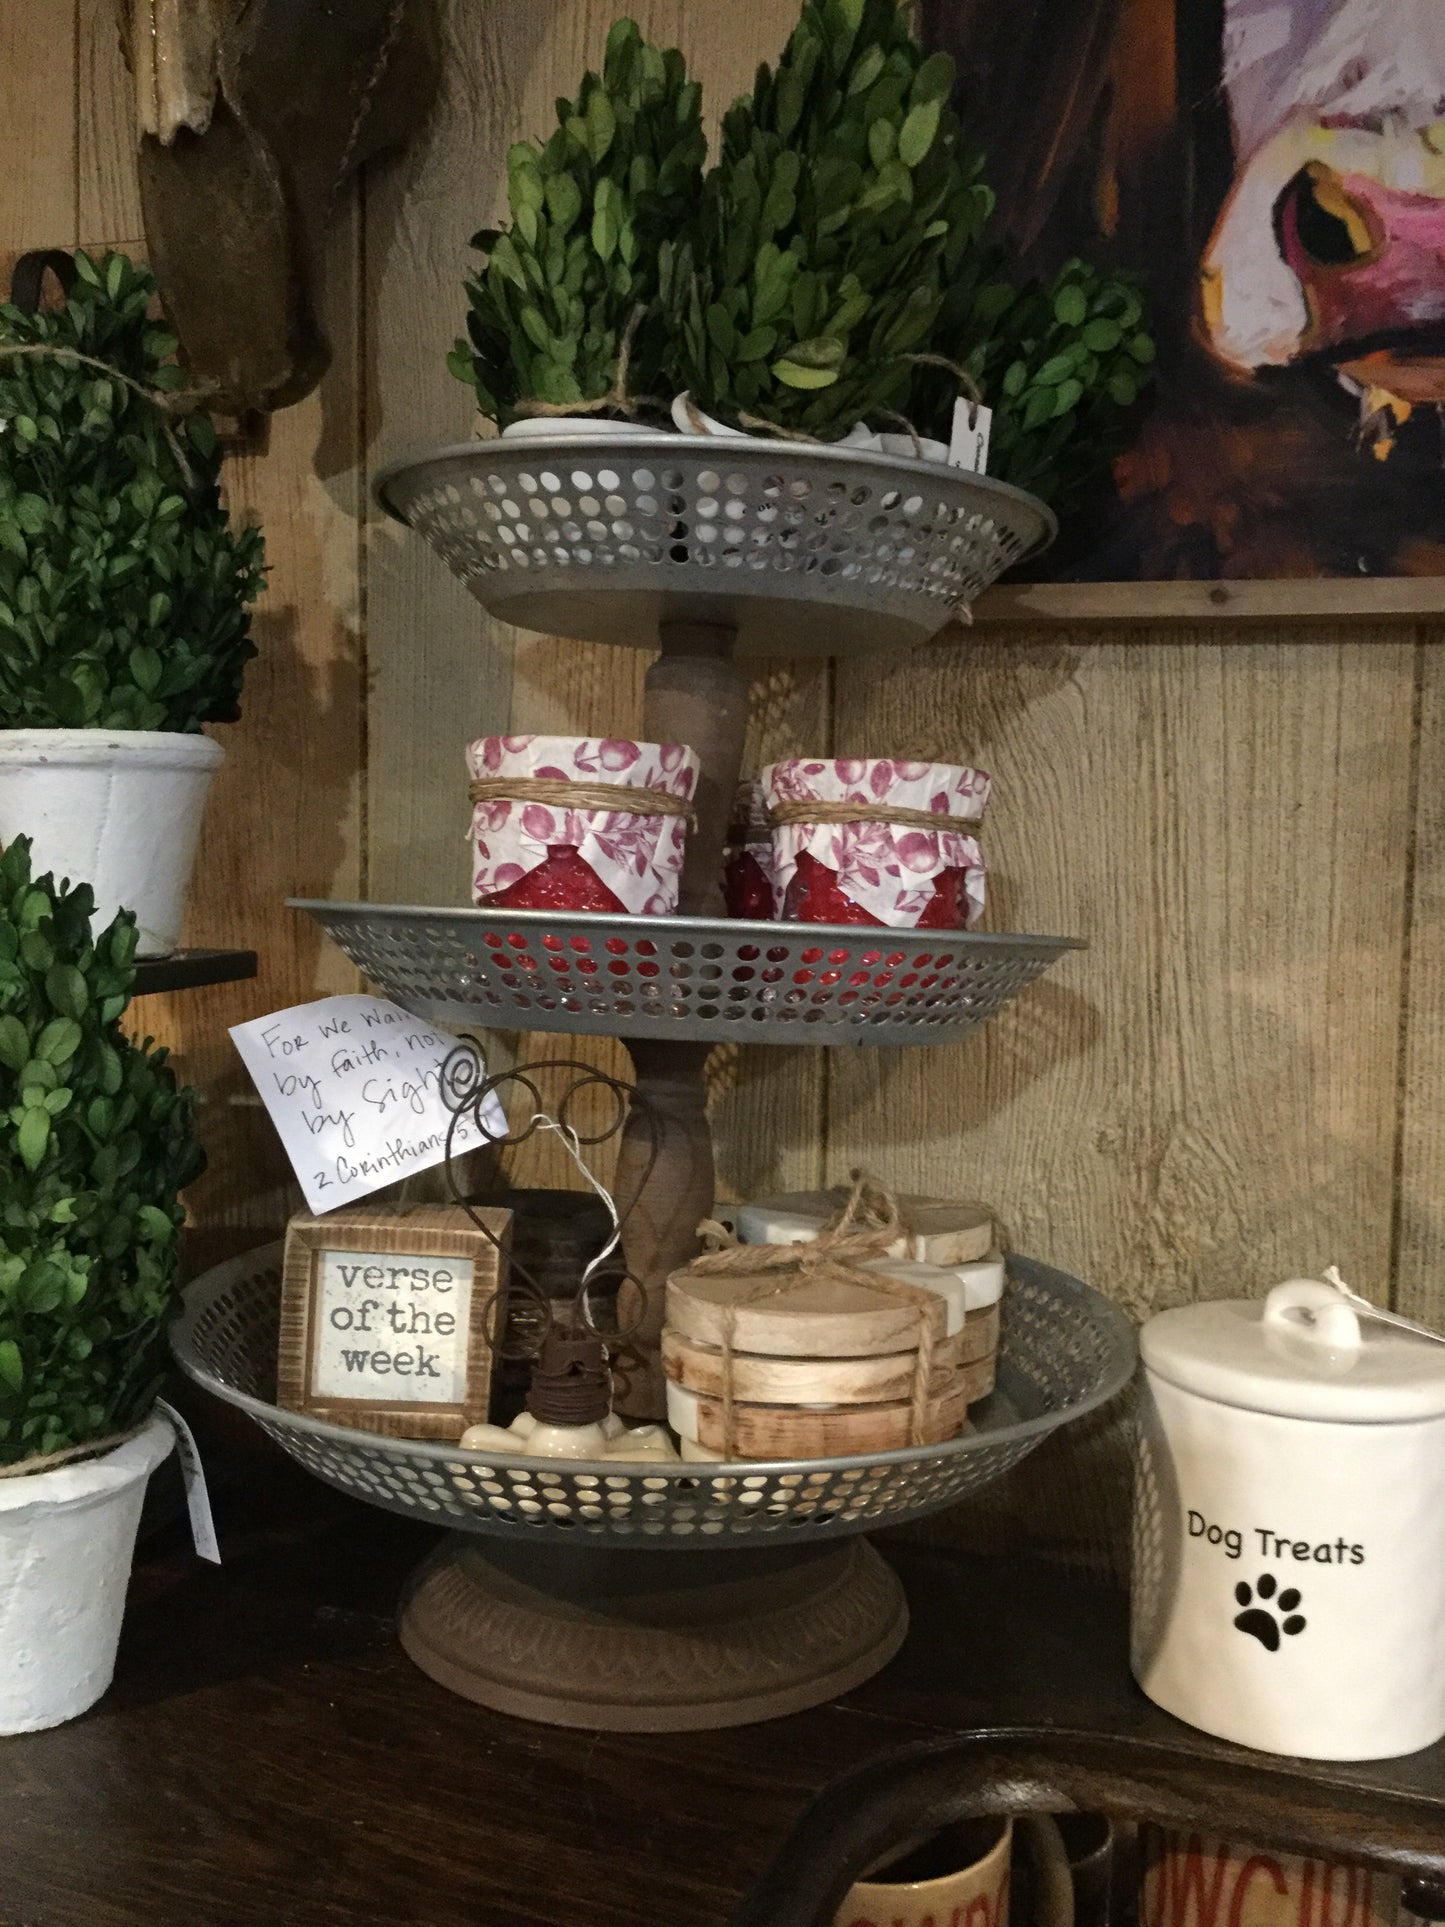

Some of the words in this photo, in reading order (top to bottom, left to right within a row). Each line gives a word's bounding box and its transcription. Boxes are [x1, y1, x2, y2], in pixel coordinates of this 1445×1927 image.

[318, 1017, 352, 1039] We
[360, 1008, 411, 1027] Wal
[273, 1072, 321, 1109] by
[406, 1031, 445, 1051] not
[302, 1110, 355, 1147] by
[313, 1171, 333, 1189] 2
[336, 1264, 454, 1293] verse
[330, 1299, 379, 1331] of
[387, 1301, 456, 1336] the
[341, 1345, 441, 1378] week
[1188, 1510, 1243, 1559] Dog
[1254, 1528, 1366, 1565] Treats
